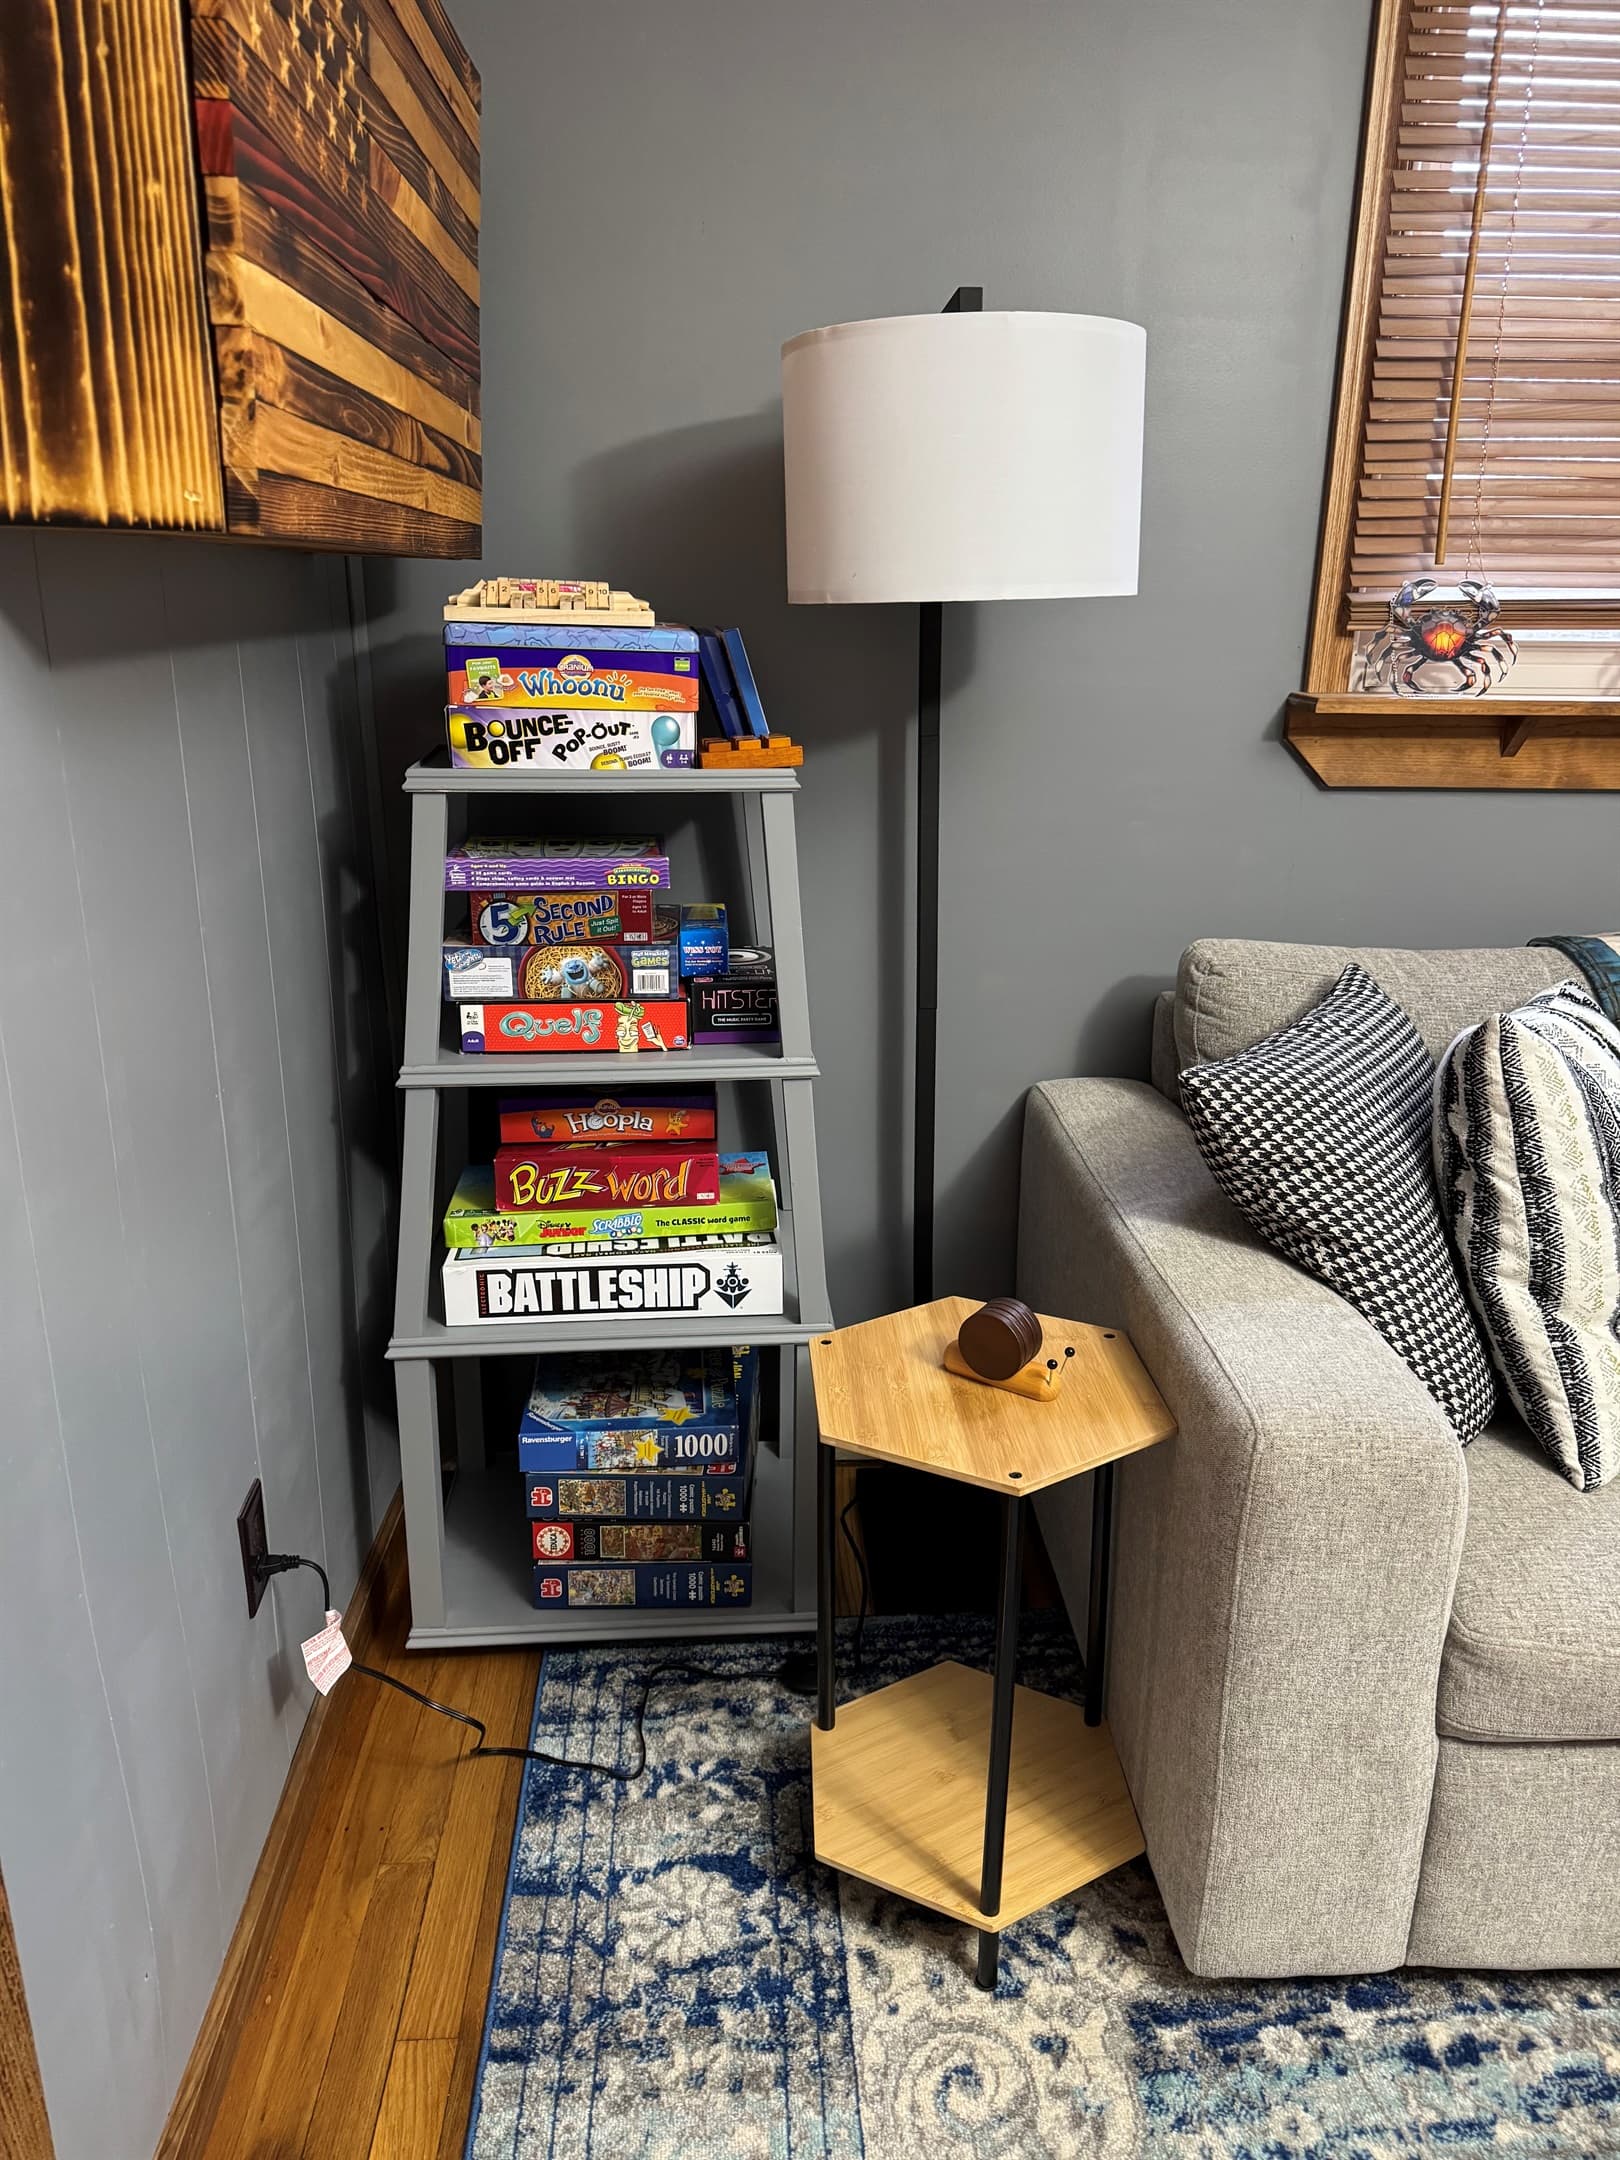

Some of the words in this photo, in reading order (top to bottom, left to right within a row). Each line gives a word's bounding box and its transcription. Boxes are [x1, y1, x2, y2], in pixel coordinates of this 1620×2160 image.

[519, 668, 625, 701] Whoonu
[464, 714, 573, 752] BOUNCE-
[552, 721, 631, 761] POP-OUT
[488, 738, 541, 765] OFF
[607, 874, 660, 885] BINGO
[490, 903, 519, 943] 5
[533, 895, 614, 923] SECOND
[591, 918, 605, 927] Just
[534, 920, 586, 944] RULE
[702, 989, 778, 1009] HITSTER
[499, 1008, 603, 1044] Quelf
[563, 1111, 654, 1134] Hoopla
[671, 1217, 706, 1226] CLASSIC
[707, 1216, 727, 1224] word
[728, 1216, 751, 1224] game
[486, 1267, 706, 1315] BATTLESHIP
[522, 1435, 573, 1444] Ravensburger
[674, 1433, 728, 1458] 1000
[679, 1485, 687, 1502] 1000
[550, 1532, 558, 1551] EDUCA
[688, 1572, 696, 1589] 1000
